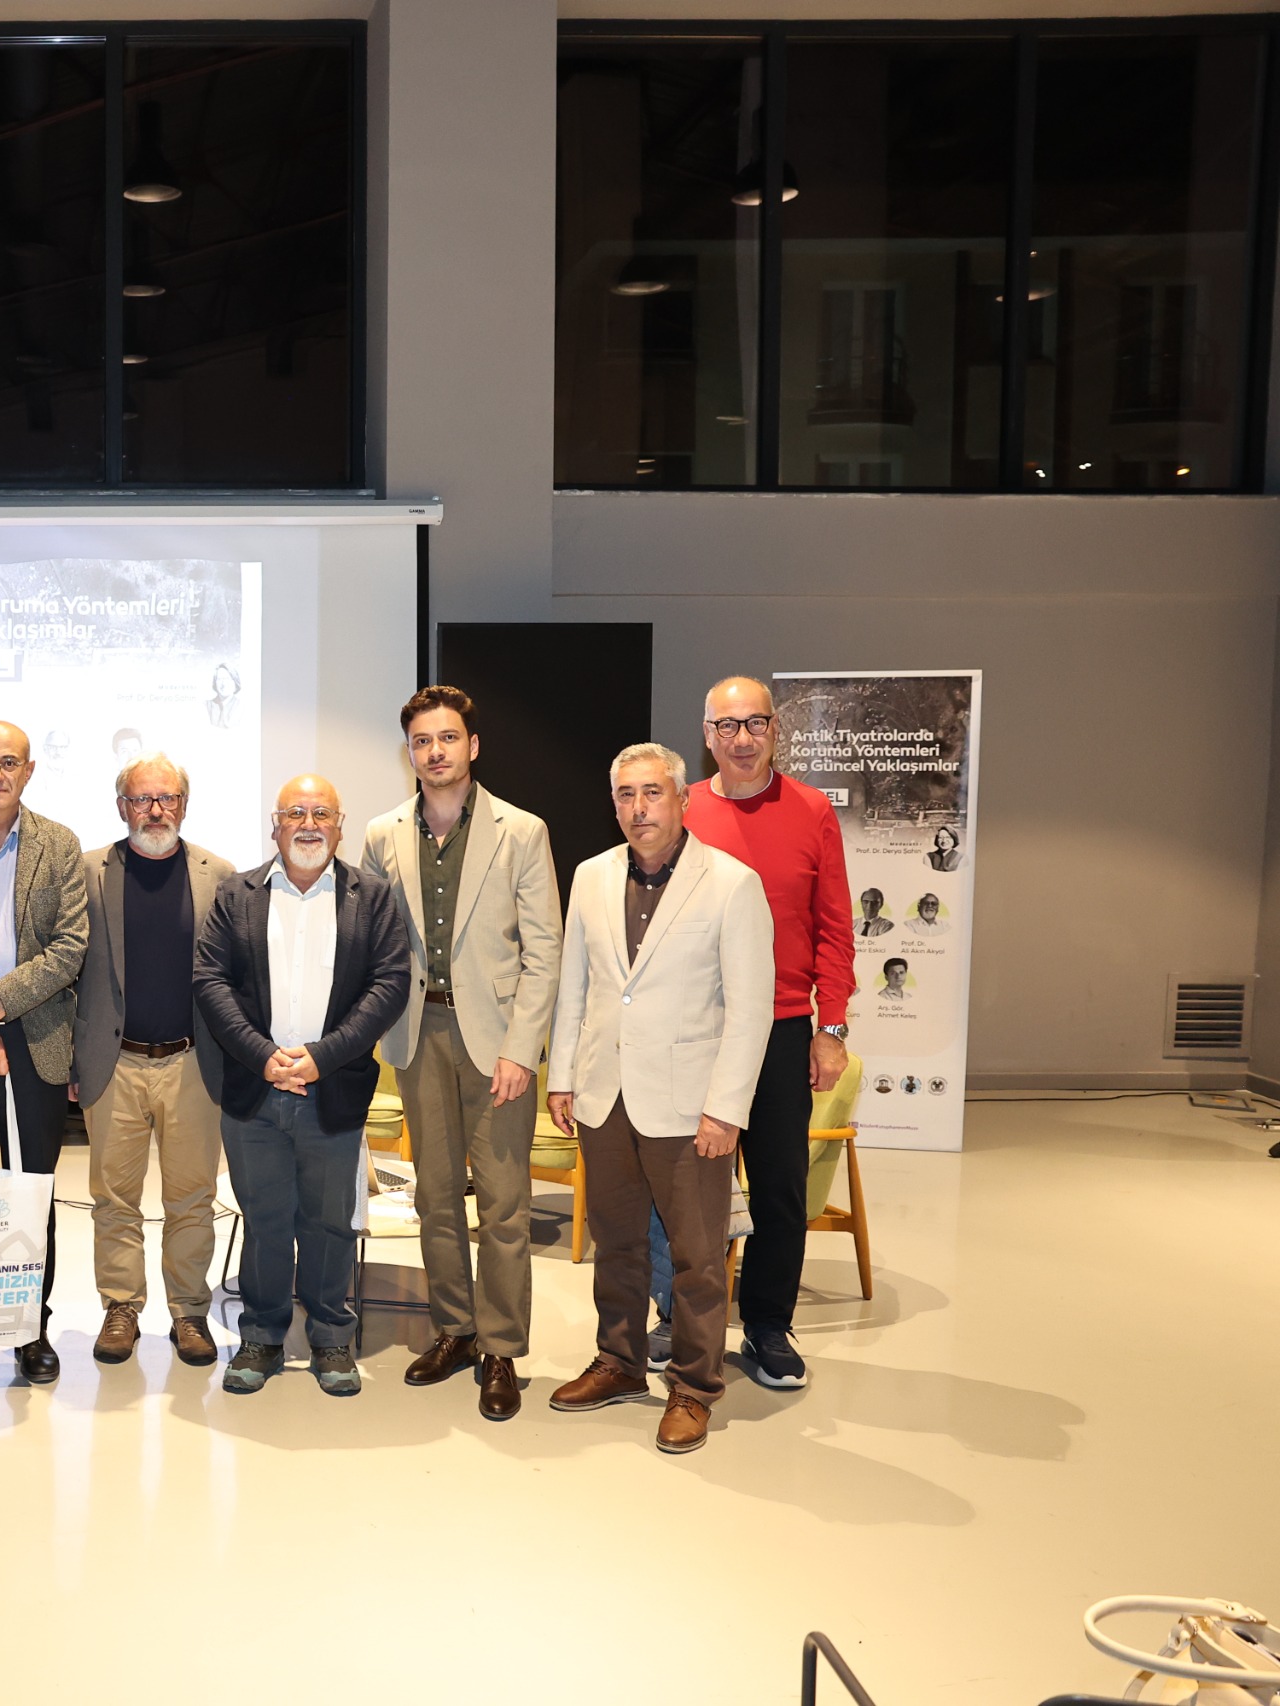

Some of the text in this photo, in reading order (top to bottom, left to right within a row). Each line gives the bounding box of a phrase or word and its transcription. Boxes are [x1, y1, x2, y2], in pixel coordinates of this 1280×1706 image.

[63, 592, 185, 616] Yöntemleri
[791, 729, 933, 744] Antik Tiyatrolarda
[790, 744, 939, 757] Koruma Yöntemleri
[789, 759, 959, 774] ve Güncel Yaklaşımlar
